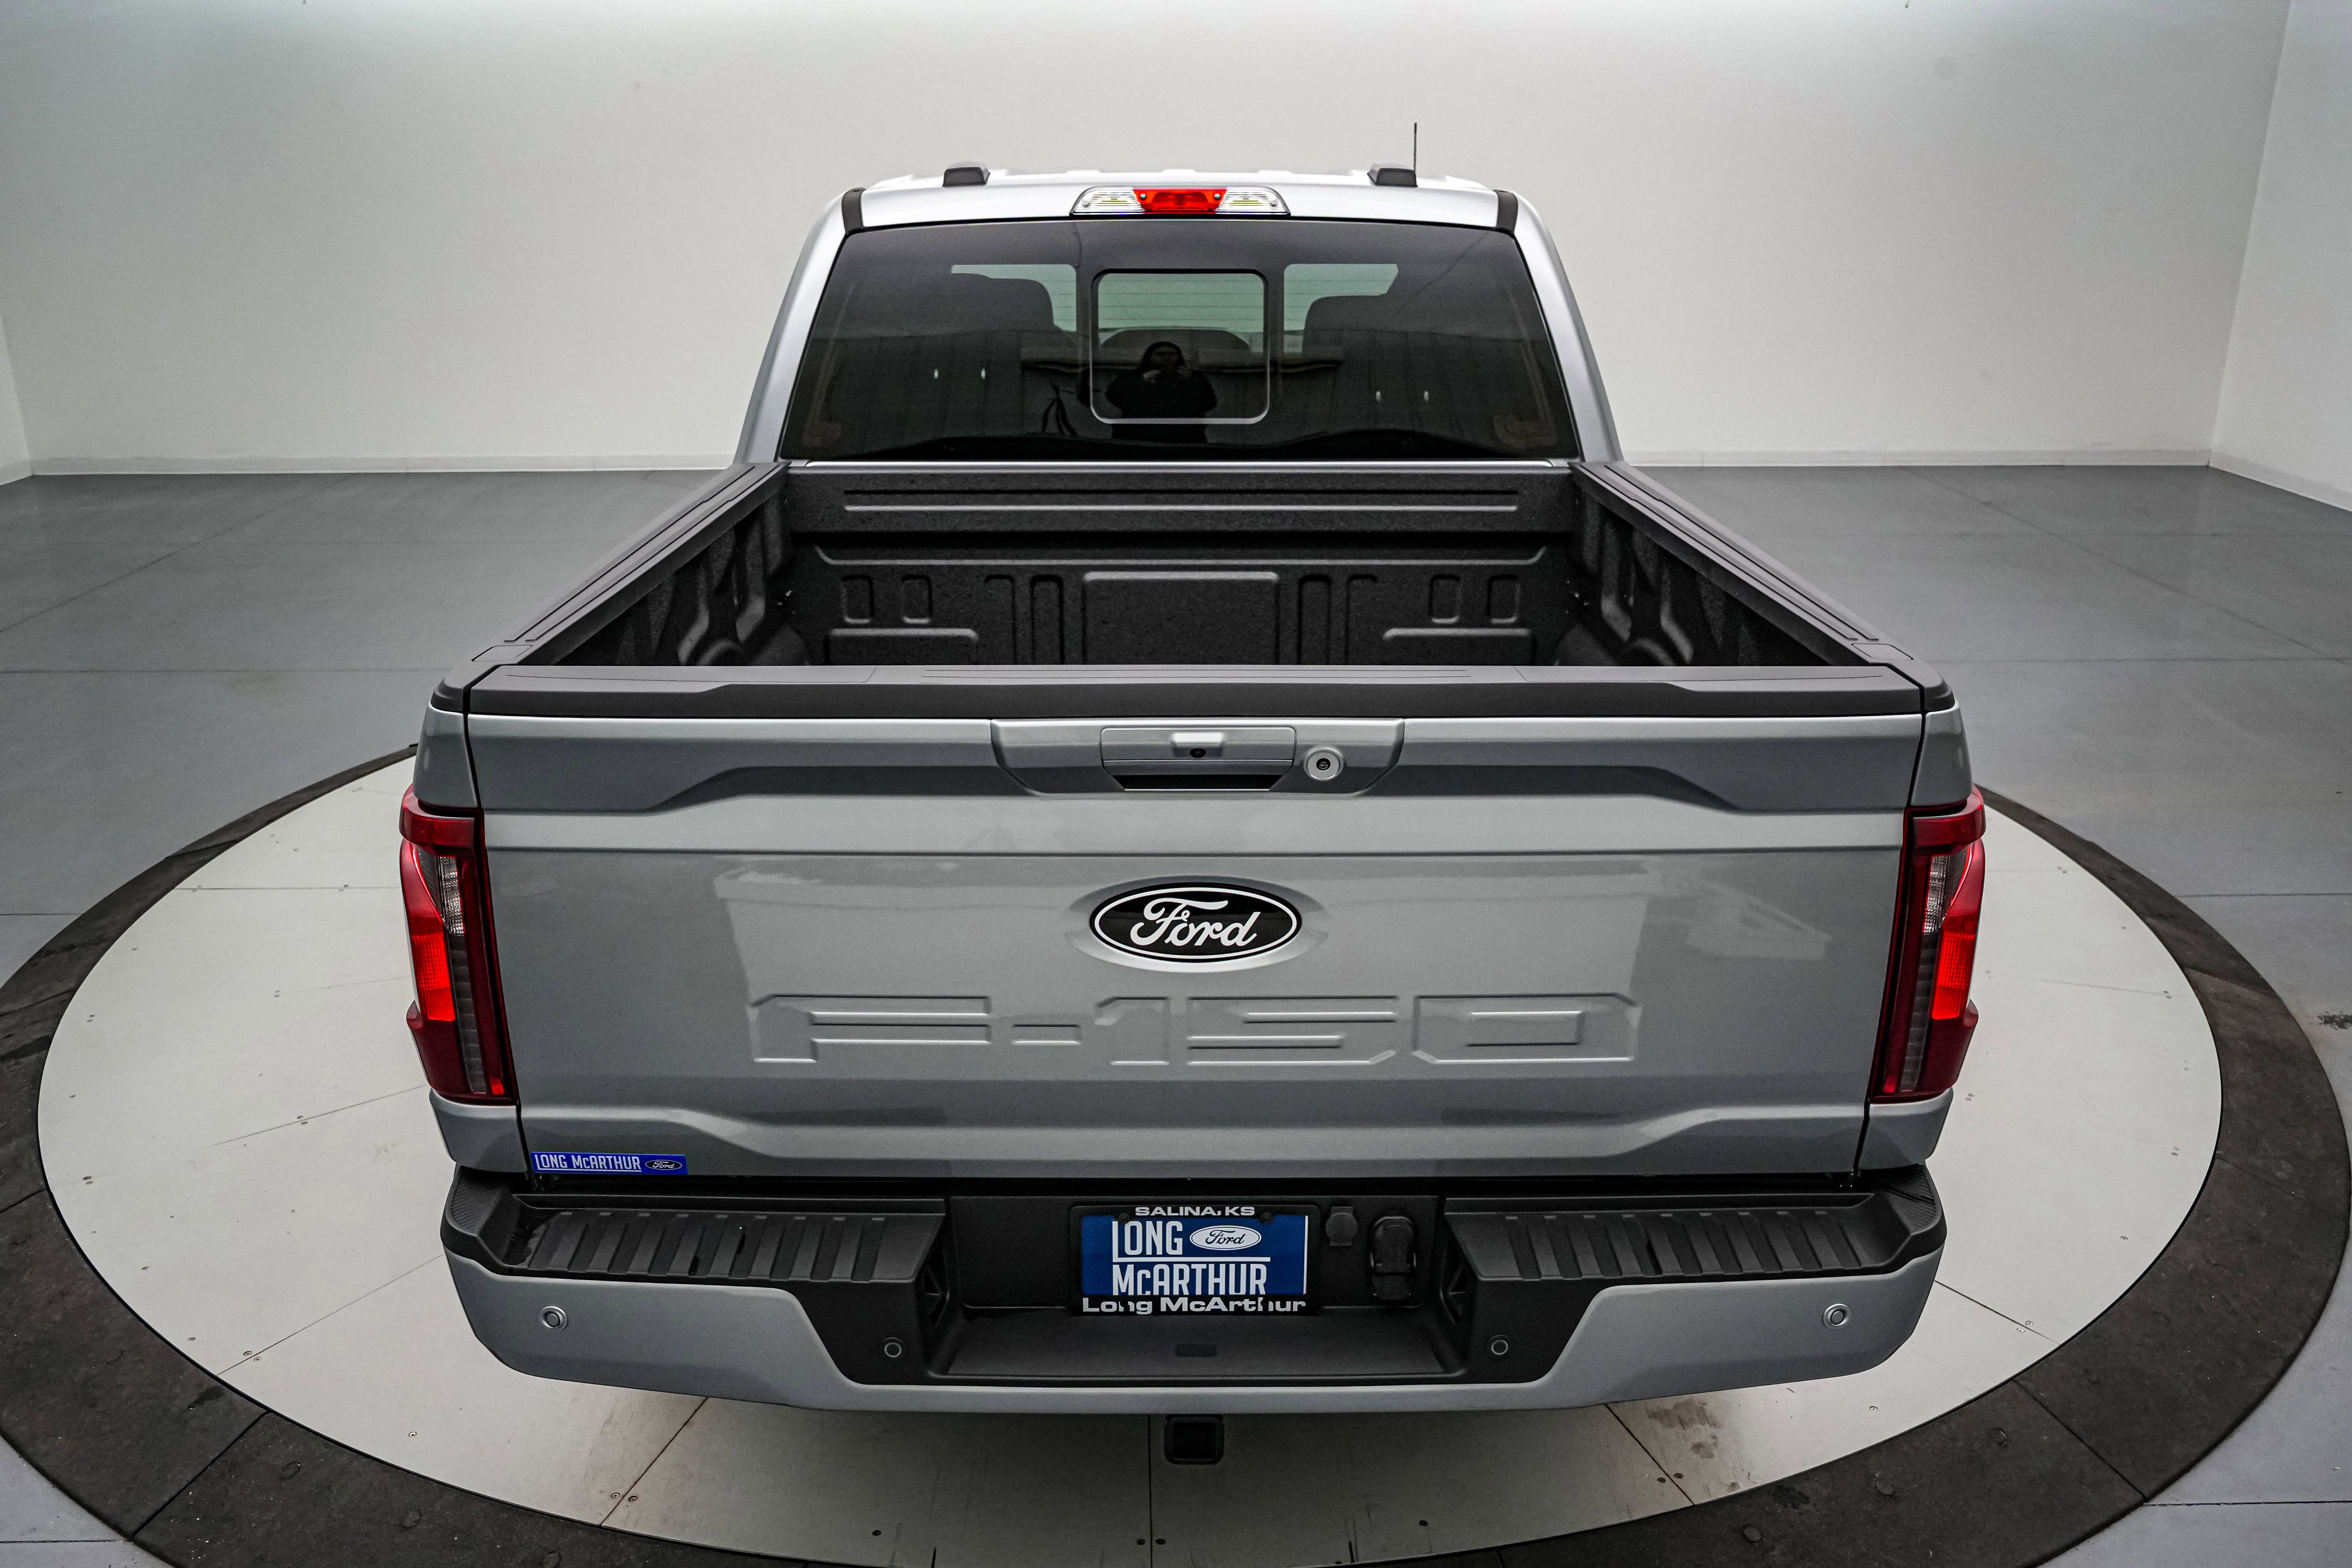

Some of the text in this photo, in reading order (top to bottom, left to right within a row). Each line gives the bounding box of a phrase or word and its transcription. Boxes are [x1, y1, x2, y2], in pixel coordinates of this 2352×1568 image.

[1130, 898, 1261, 946] Ford
[750, 993, 1642, 1065] F-150
[535, 1154, 641, 1170] LONG McARTHUR
[653, 1160, 675, 1169] Ford
[1135, 1206, 1255, 1216] SALINA, KS
[1112, 1221, 1183, 1263] LONG
[1205, 1229, 1246, 1245] Ford
[1112, 1264, 1267, 1296] McARTHUR
[1082, 1296, 1306, 1315] Long McArthur
